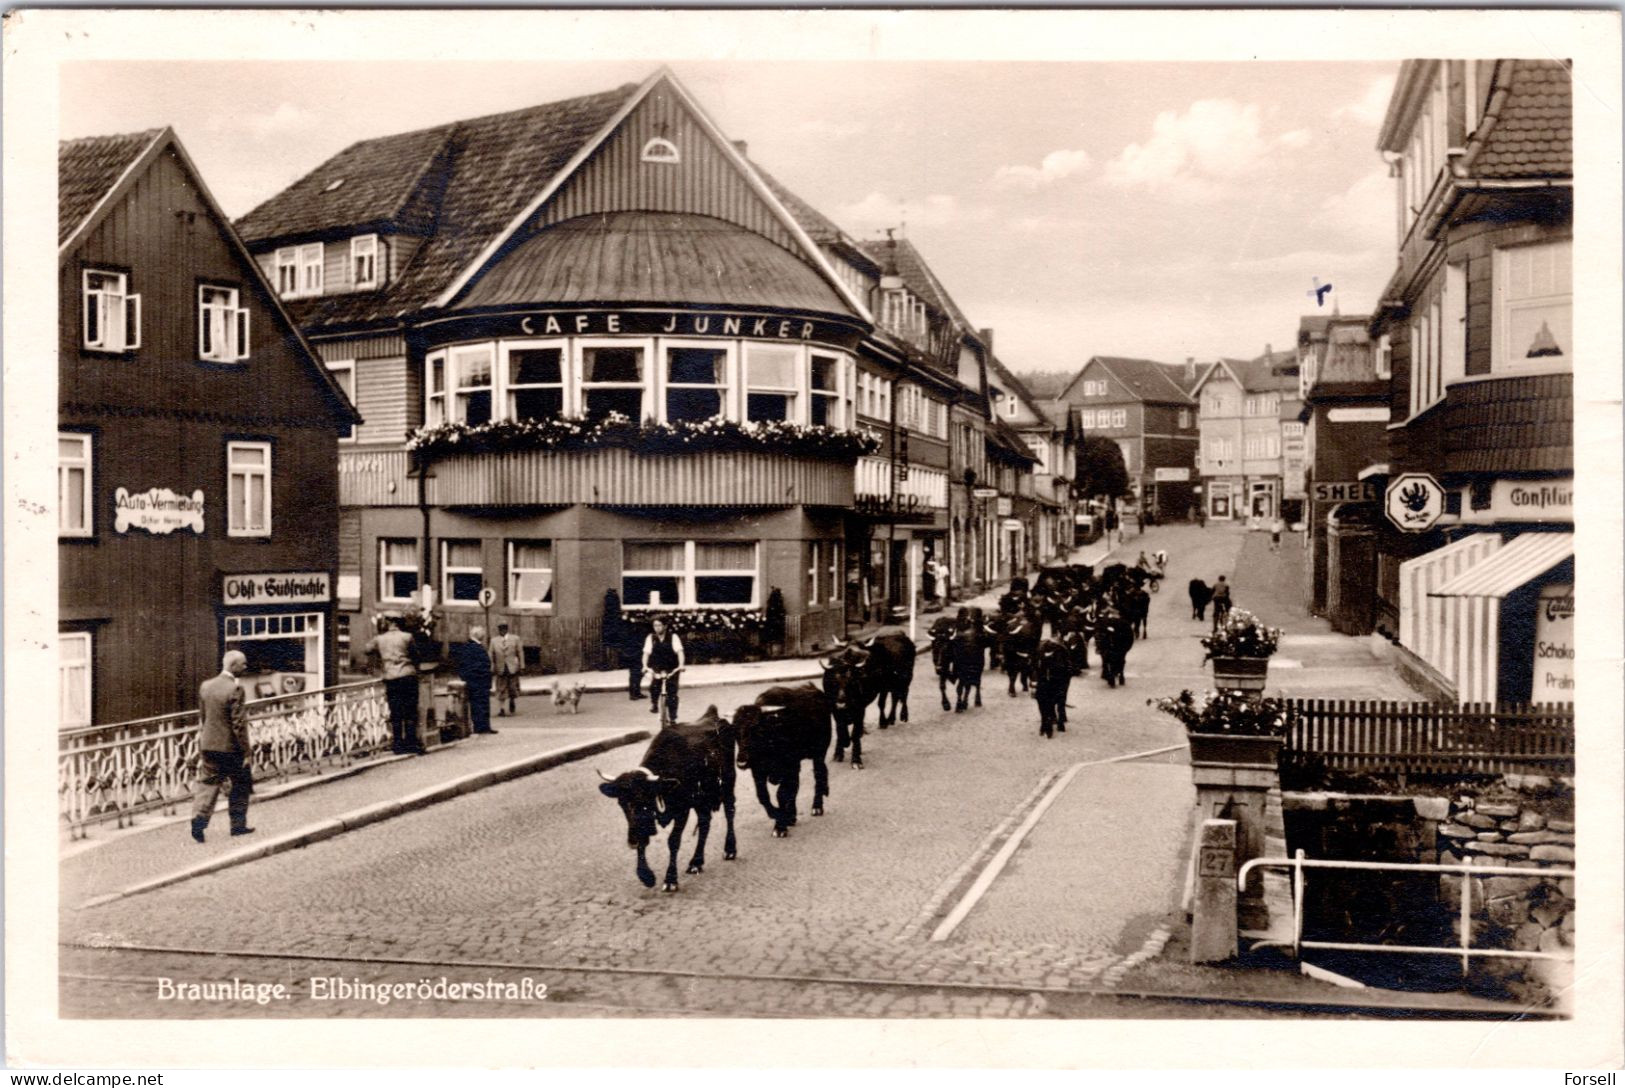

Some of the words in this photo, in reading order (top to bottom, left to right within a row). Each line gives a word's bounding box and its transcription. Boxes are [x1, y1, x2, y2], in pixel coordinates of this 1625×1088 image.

[521, 314, 621, 335] CAFE
[663, 315, 814, 339] JUNKER
[117, 493, 202, 514] Auto-Vermietung
[484, 590, 492, 605] P
[1206, 852, 1229, 872] 27
